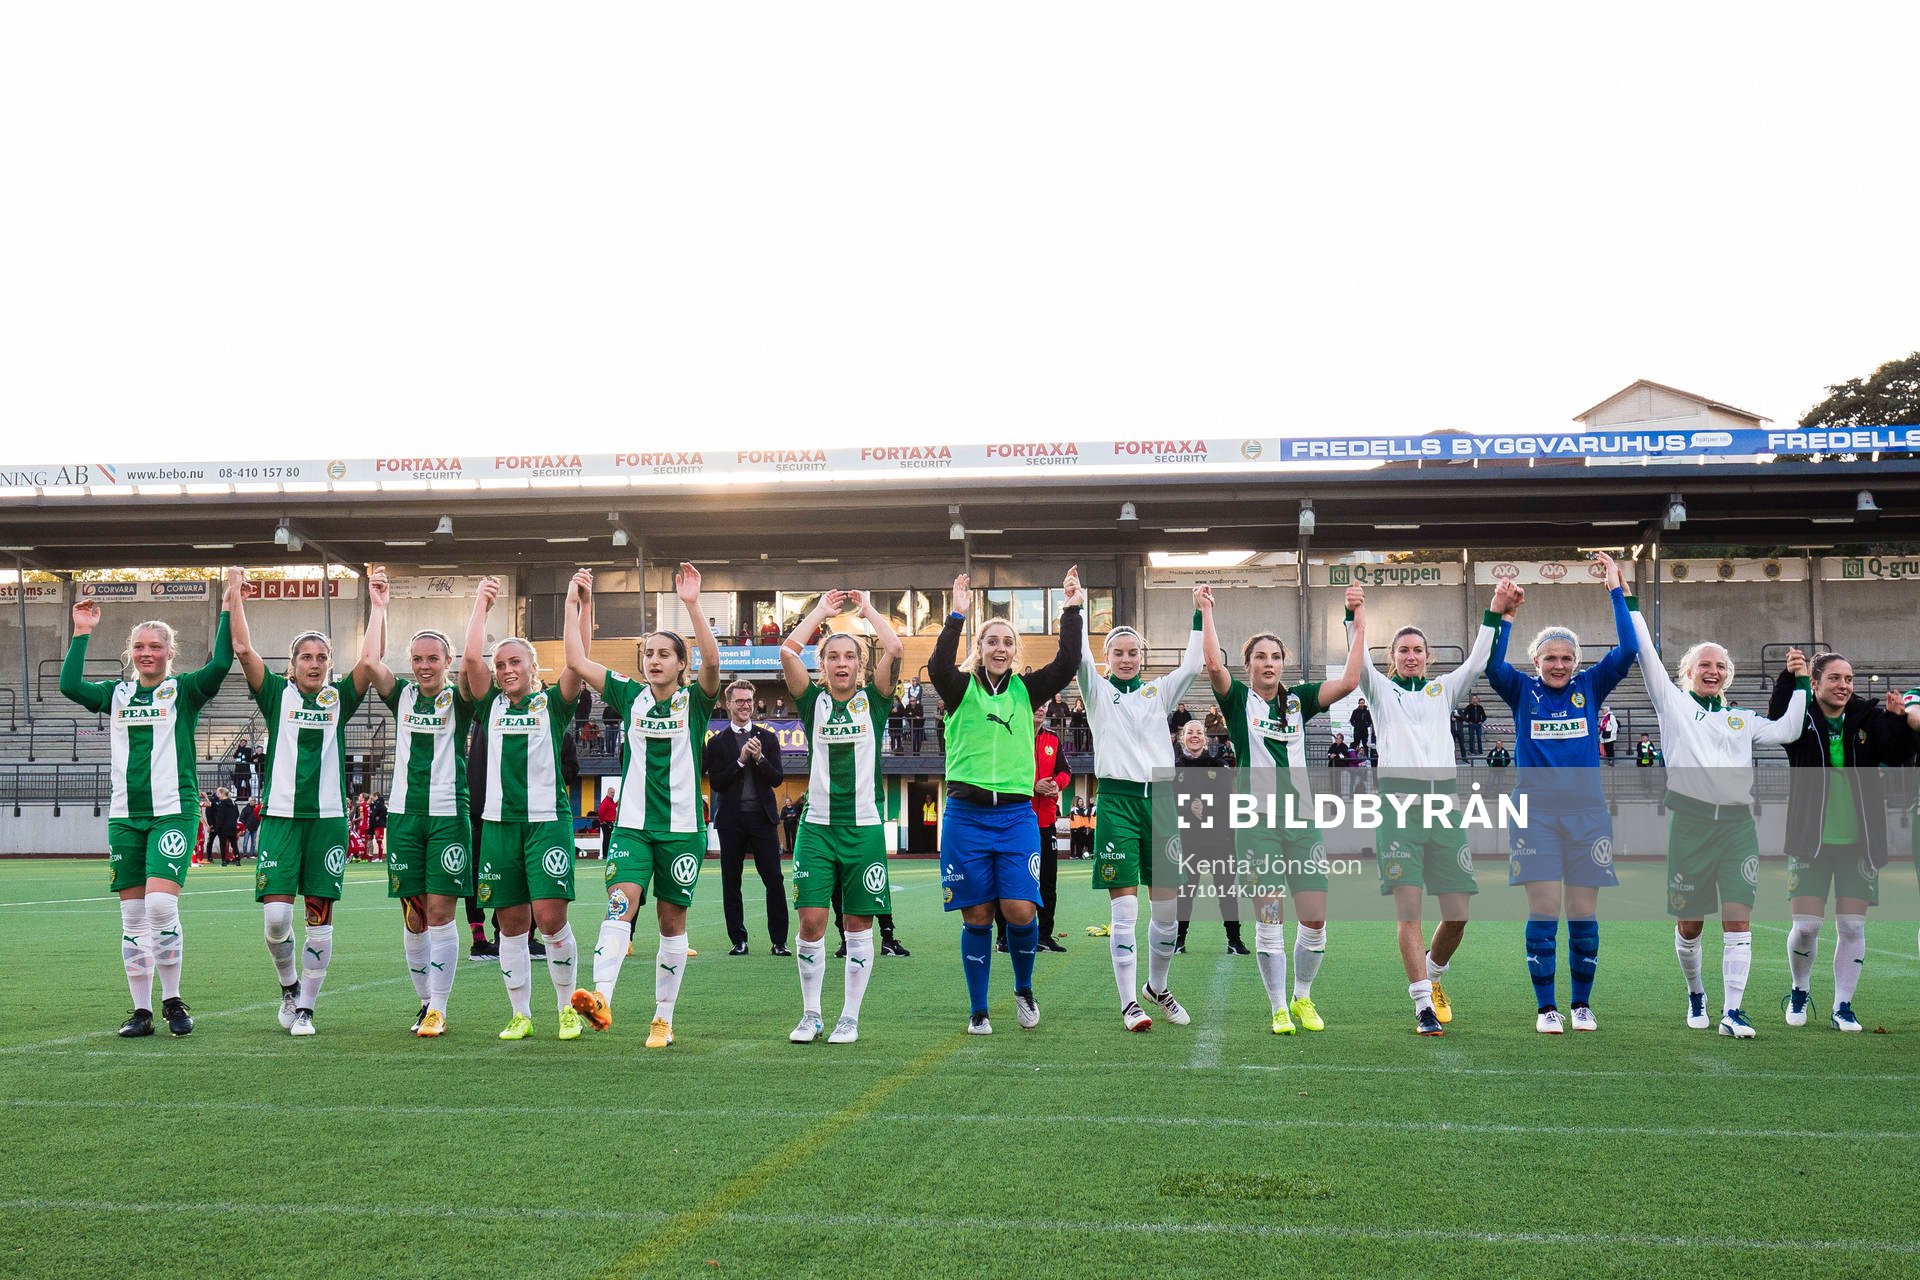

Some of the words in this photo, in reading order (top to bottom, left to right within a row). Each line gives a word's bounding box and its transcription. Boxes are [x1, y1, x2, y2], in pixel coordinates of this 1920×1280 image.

[986, 442, 1079, 458] FORTAXA
[1114, 440, 1208, 455] FORTAXA
[1292, 438, 1440, 457] FREDELLS
[1452, 434, 1686, 455] BYGGVARUHUS
[737, 450, 827, 464] FORTAXA
[861, 446, 952, 461] FORTAXA
[495, 455, 582, 469] FORTAXA
[615, 452, 703, 467] FORTAXA
[1026, 457, 1078, 466] SECURITY
[1154, 455, 1207, 463] SECURITY
[375, 458, 462, 472] FORTAXA
[776, 463, 827, 472] SECURITY
[900, 460, 952, 469] SECURITY
[53, 465, 89, 485] AB
[127, 468, 204, 480] www.bebo.nu
[219, 467, 258, 479] 08-410
[262, 467, 283, 478] 157
[286, 466, 300, 477] 80
[412, 471, 462, 480] SECURITY
[532, 469, 582, 477] SECURITY
[652, 466, 703, 475] SECURITY
[1354, 564, 1441, 584] Q-gruppen
[1494, 566, 1517, 576] AXA
[1542, 565, 1565, 576] AXA
[1591, 565, 1606, 575] AX
[97, 584, 135, 594] CORVARA
[166, 583, 204, 593] CORVARA
[1113, 693, 1121, 704] 2
[122, 708, 160, 718] PEAB
[294, 711, 329, 721] PEAB
[408, 715, 442, 725] PEAB
[499, 717, 536, 726] PEAB
[640, 720, 678, 729] PEAB
[822, 726, 861, 735] PEAB
[1539, 722, 1580, 731] PEAB
